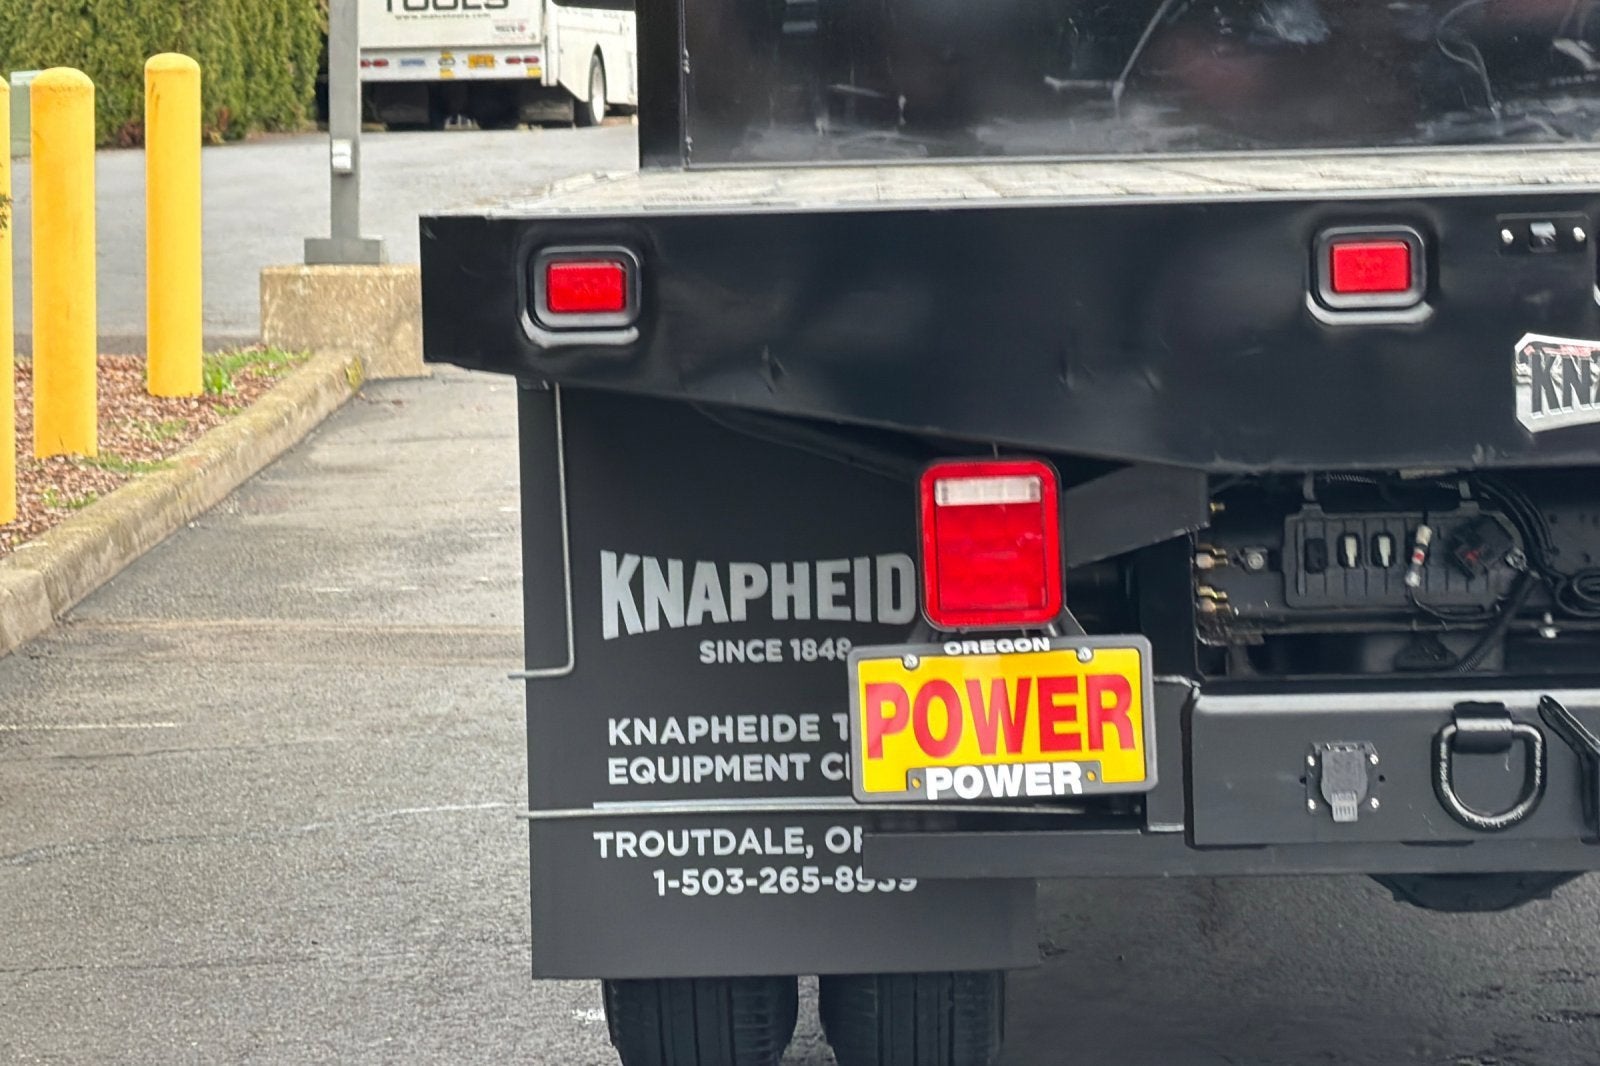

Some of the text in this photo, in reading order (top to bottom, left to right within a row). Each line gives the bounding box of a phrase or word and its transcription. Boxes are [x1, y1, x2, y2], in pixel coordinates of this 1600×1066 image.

[1531, 350, 1600, 414] KN
[699, 636, 852, 664] SINCE 1848
[943, 637, 1051, 655] OREGON
[608, 713, 820, 746] KNAPHEIDE
[865, 673, 1136, 760] POWER
[608, 753, 811, 785] EQUIPMENT
[925, 762, 1083, 801] POWER
[593, 827, 814, 859] TROUTDALE,
